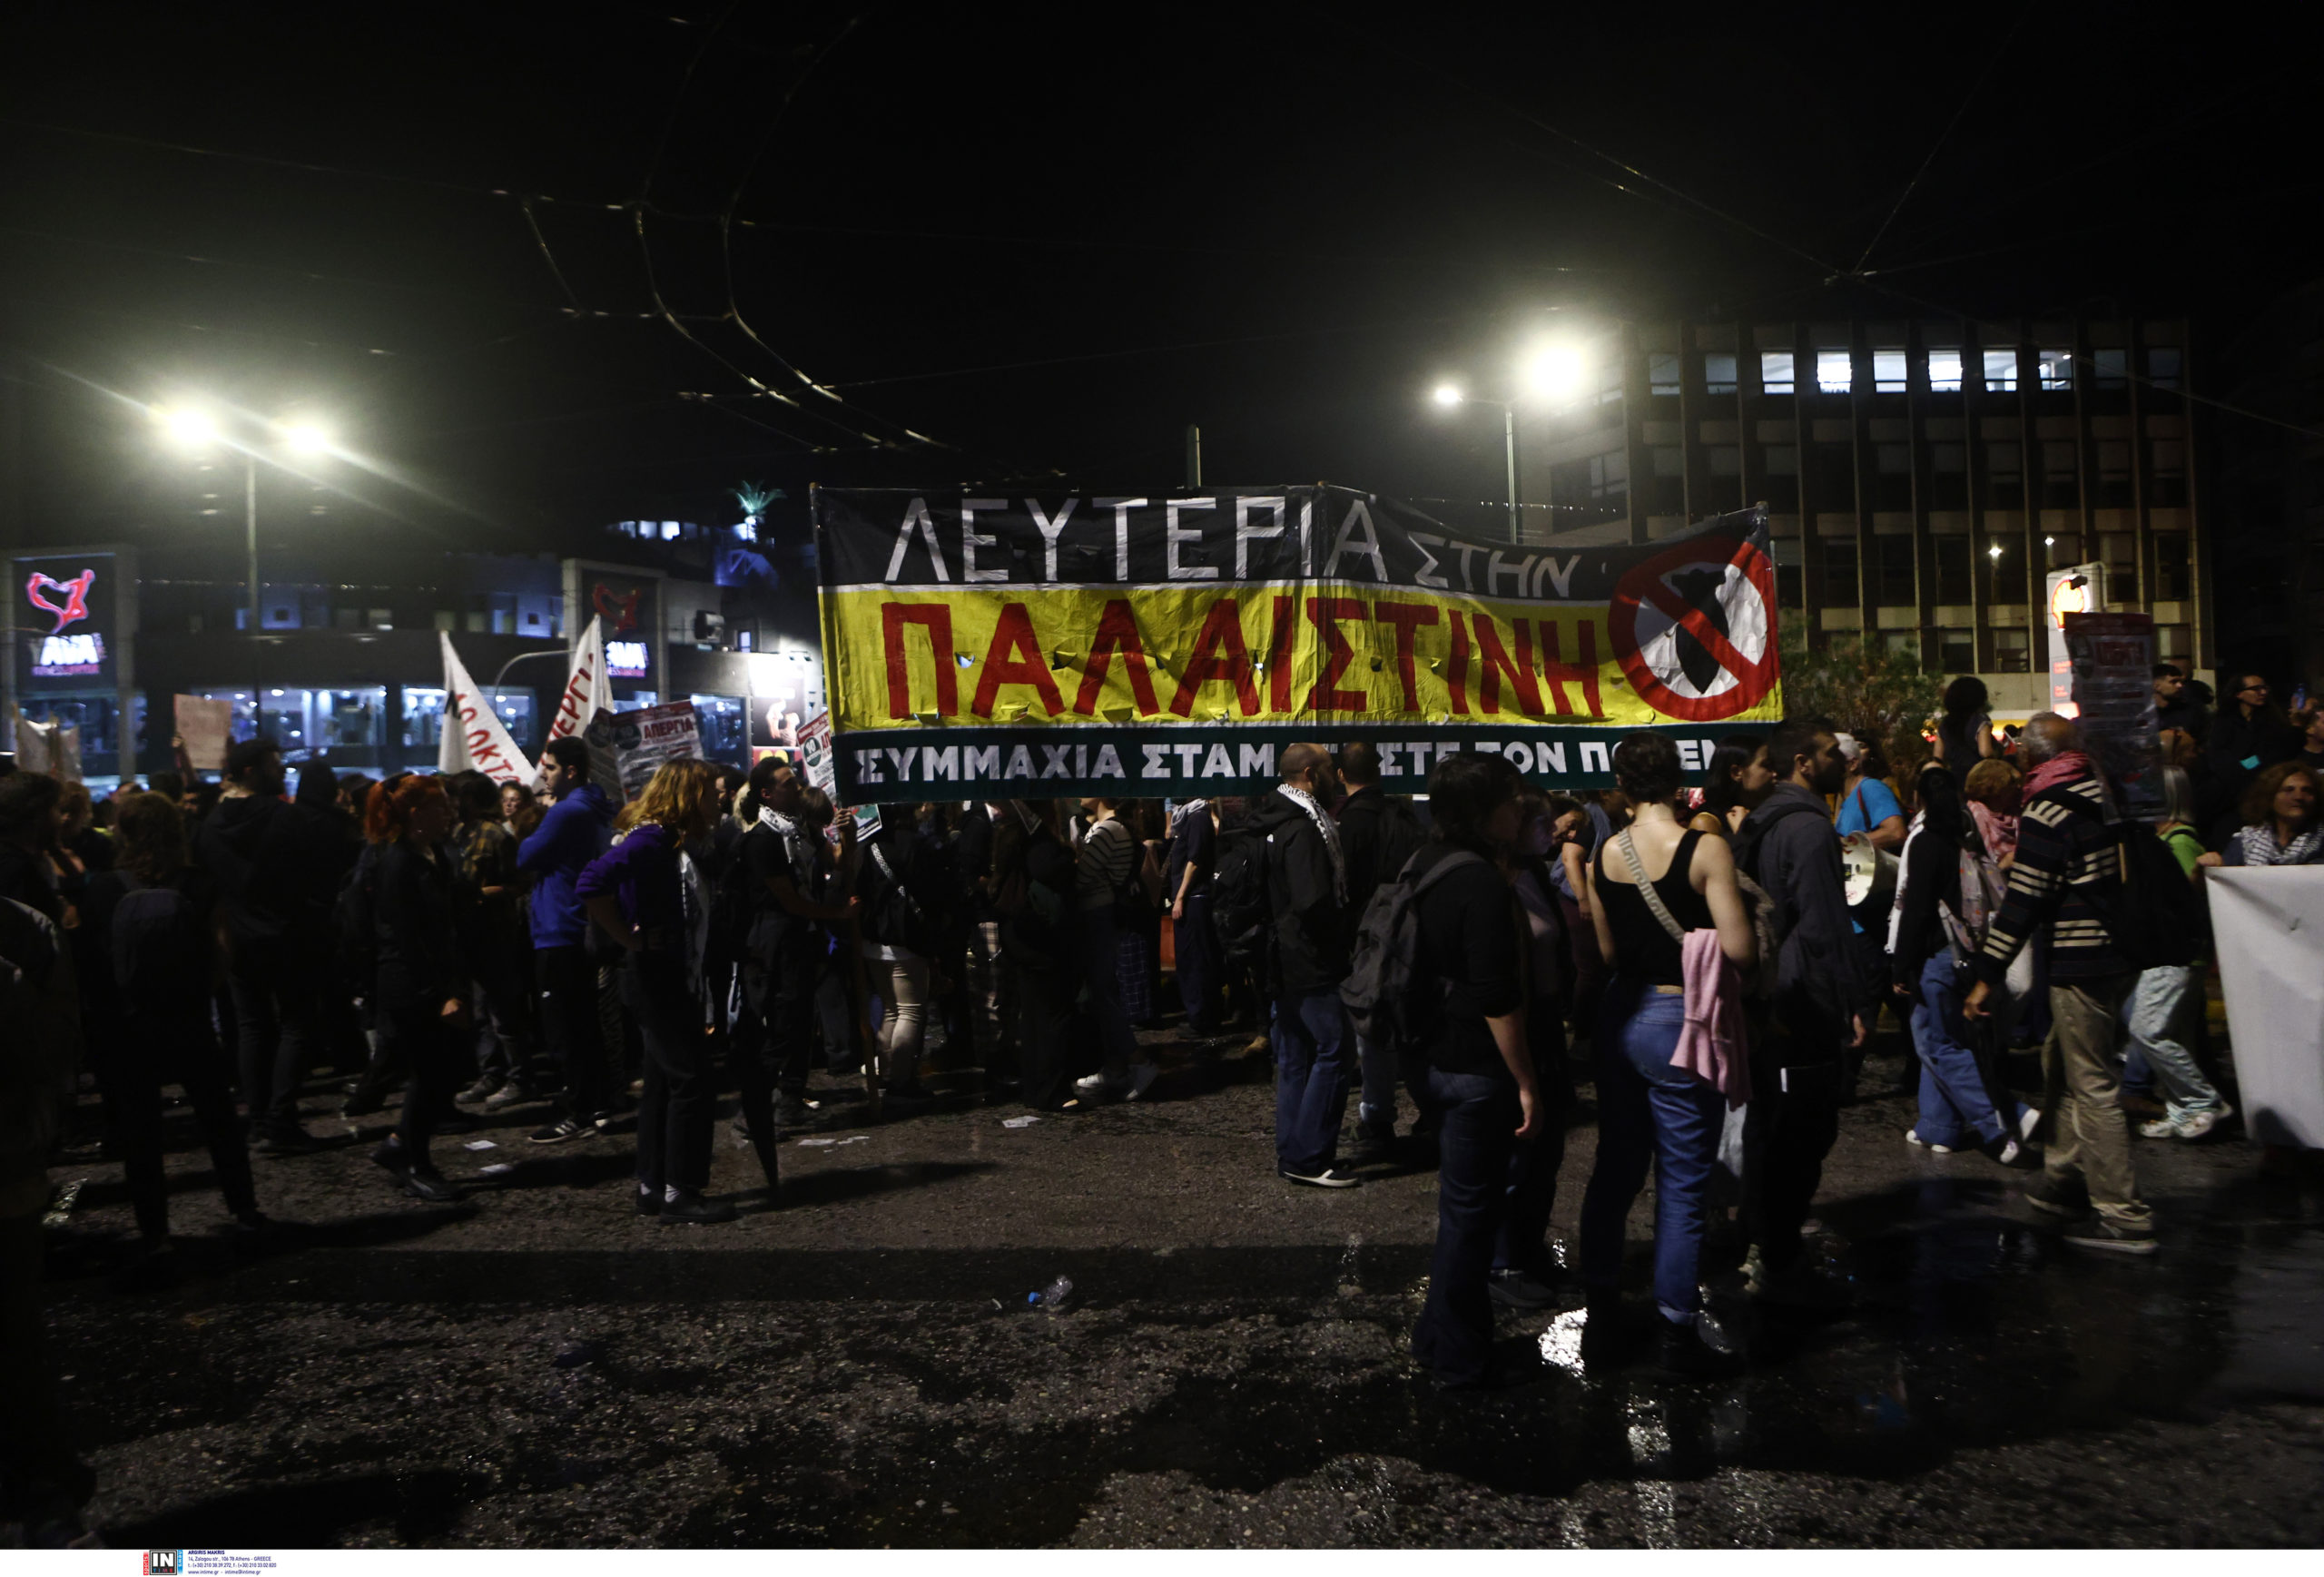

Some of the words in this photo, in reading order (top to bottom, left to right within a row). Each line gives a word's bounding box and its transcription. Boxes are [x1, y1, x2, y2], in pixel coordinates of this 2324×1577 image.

[884, 496, 1388, 583] ΛΕΥΤΕΡΙΑ
[1406, 529, 1581, 599] ΣΤΗΝ
[881, 595, 1604, 719] ΠΑΛΑΙΣΤΙΝΗ
[644, 717, 694, 740] ΑΠΕΡΓΙΑ
[805, 738, 817, 754] 10
[853, 743, 1127, 785] ΣΥΜΜΑΧΙΑ
[1141, 741, 1460, 778] ΣΤΑΜΣΤ
